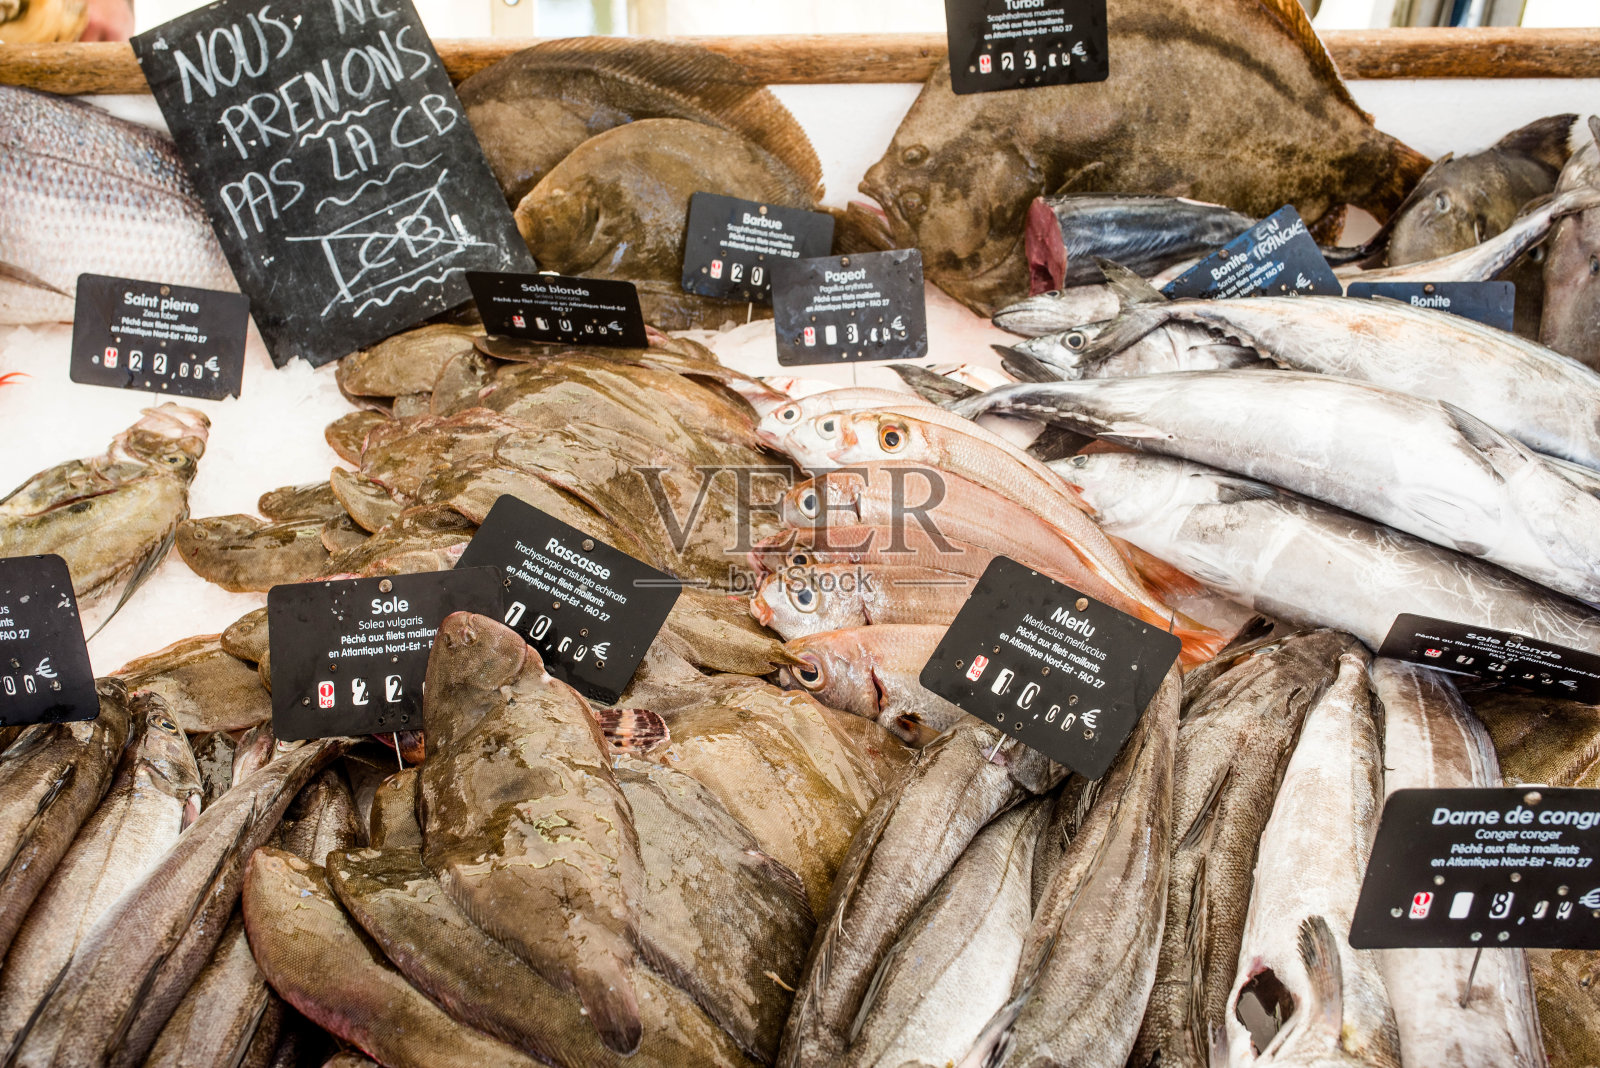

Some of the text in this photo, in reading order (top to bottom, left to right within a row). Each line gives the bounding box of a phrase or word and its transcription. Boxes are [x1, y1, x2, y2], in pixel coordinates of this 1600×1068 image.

[173, 5, 294, 103] NOUS
[218, 26, 431, 159] PRENONS
[220, 94, 457, 240] PAS LA CB
[742, 212, 783, 230] Barbue
[1255, 218, 1280, 241] EN
[824, 268, 867, 285] Pageot
[520, 283, 590, 296] Sole blonde
[124, 291, 199, 314] Saint pierre
[1411, 295, 1451, 308] Bonite
[142, 308, 160, 319] Zeus
[545, 537, 611, 580] Rascasse
[506, 565, 611, 622] en Atlantique Nord-Est FAO 27
[543, 572, 558, 583] aux
[557, 577, 574, 592] filets
[573, 586, 605, 608] maillants
[562, 567, 596, 588] cristulata
[594, 584, 627, 605] echinata
[371, 596, 409, 615] Sole
[358, 615, 423, 630] Solea vulgaris
[1050, 607, 1096, 638] Merlu
[19, 629, 30, 639] 27
[341, 633, 367, 645] Pêché
[368, 634, 385, 643] aux
[385, 630, 406, 641] filets
[1022, 613, 1107, 661] Merluccius merluccius
[328, 650, 340, 659] en
[341, 646, 384, 658] Atlantique
[385, 641, 421, 653] Nord-Est
[1037, 637, 1052, 649] aux
[1051, 642, 1069, 658] filets
[1067, 653, 1101, 674] maillants
[1465, 633, 1562, 660] Sole blonde
[999, 632, 1106, 689] en Atlantique Nord-Est FAO 27
[1431, 808, 1500, 825] Darne
[1504, 805, 1534, 824] de
[1475, 829, 1563, 842] Conger conger
[1484, 845, 1506, 854] aux
[1506, 843, 1531, 854] filets
[1531, 843, 1581, 855] maillants
[1430, 856, 1593, 869] en Atlantique Nord-Est FAO 27
